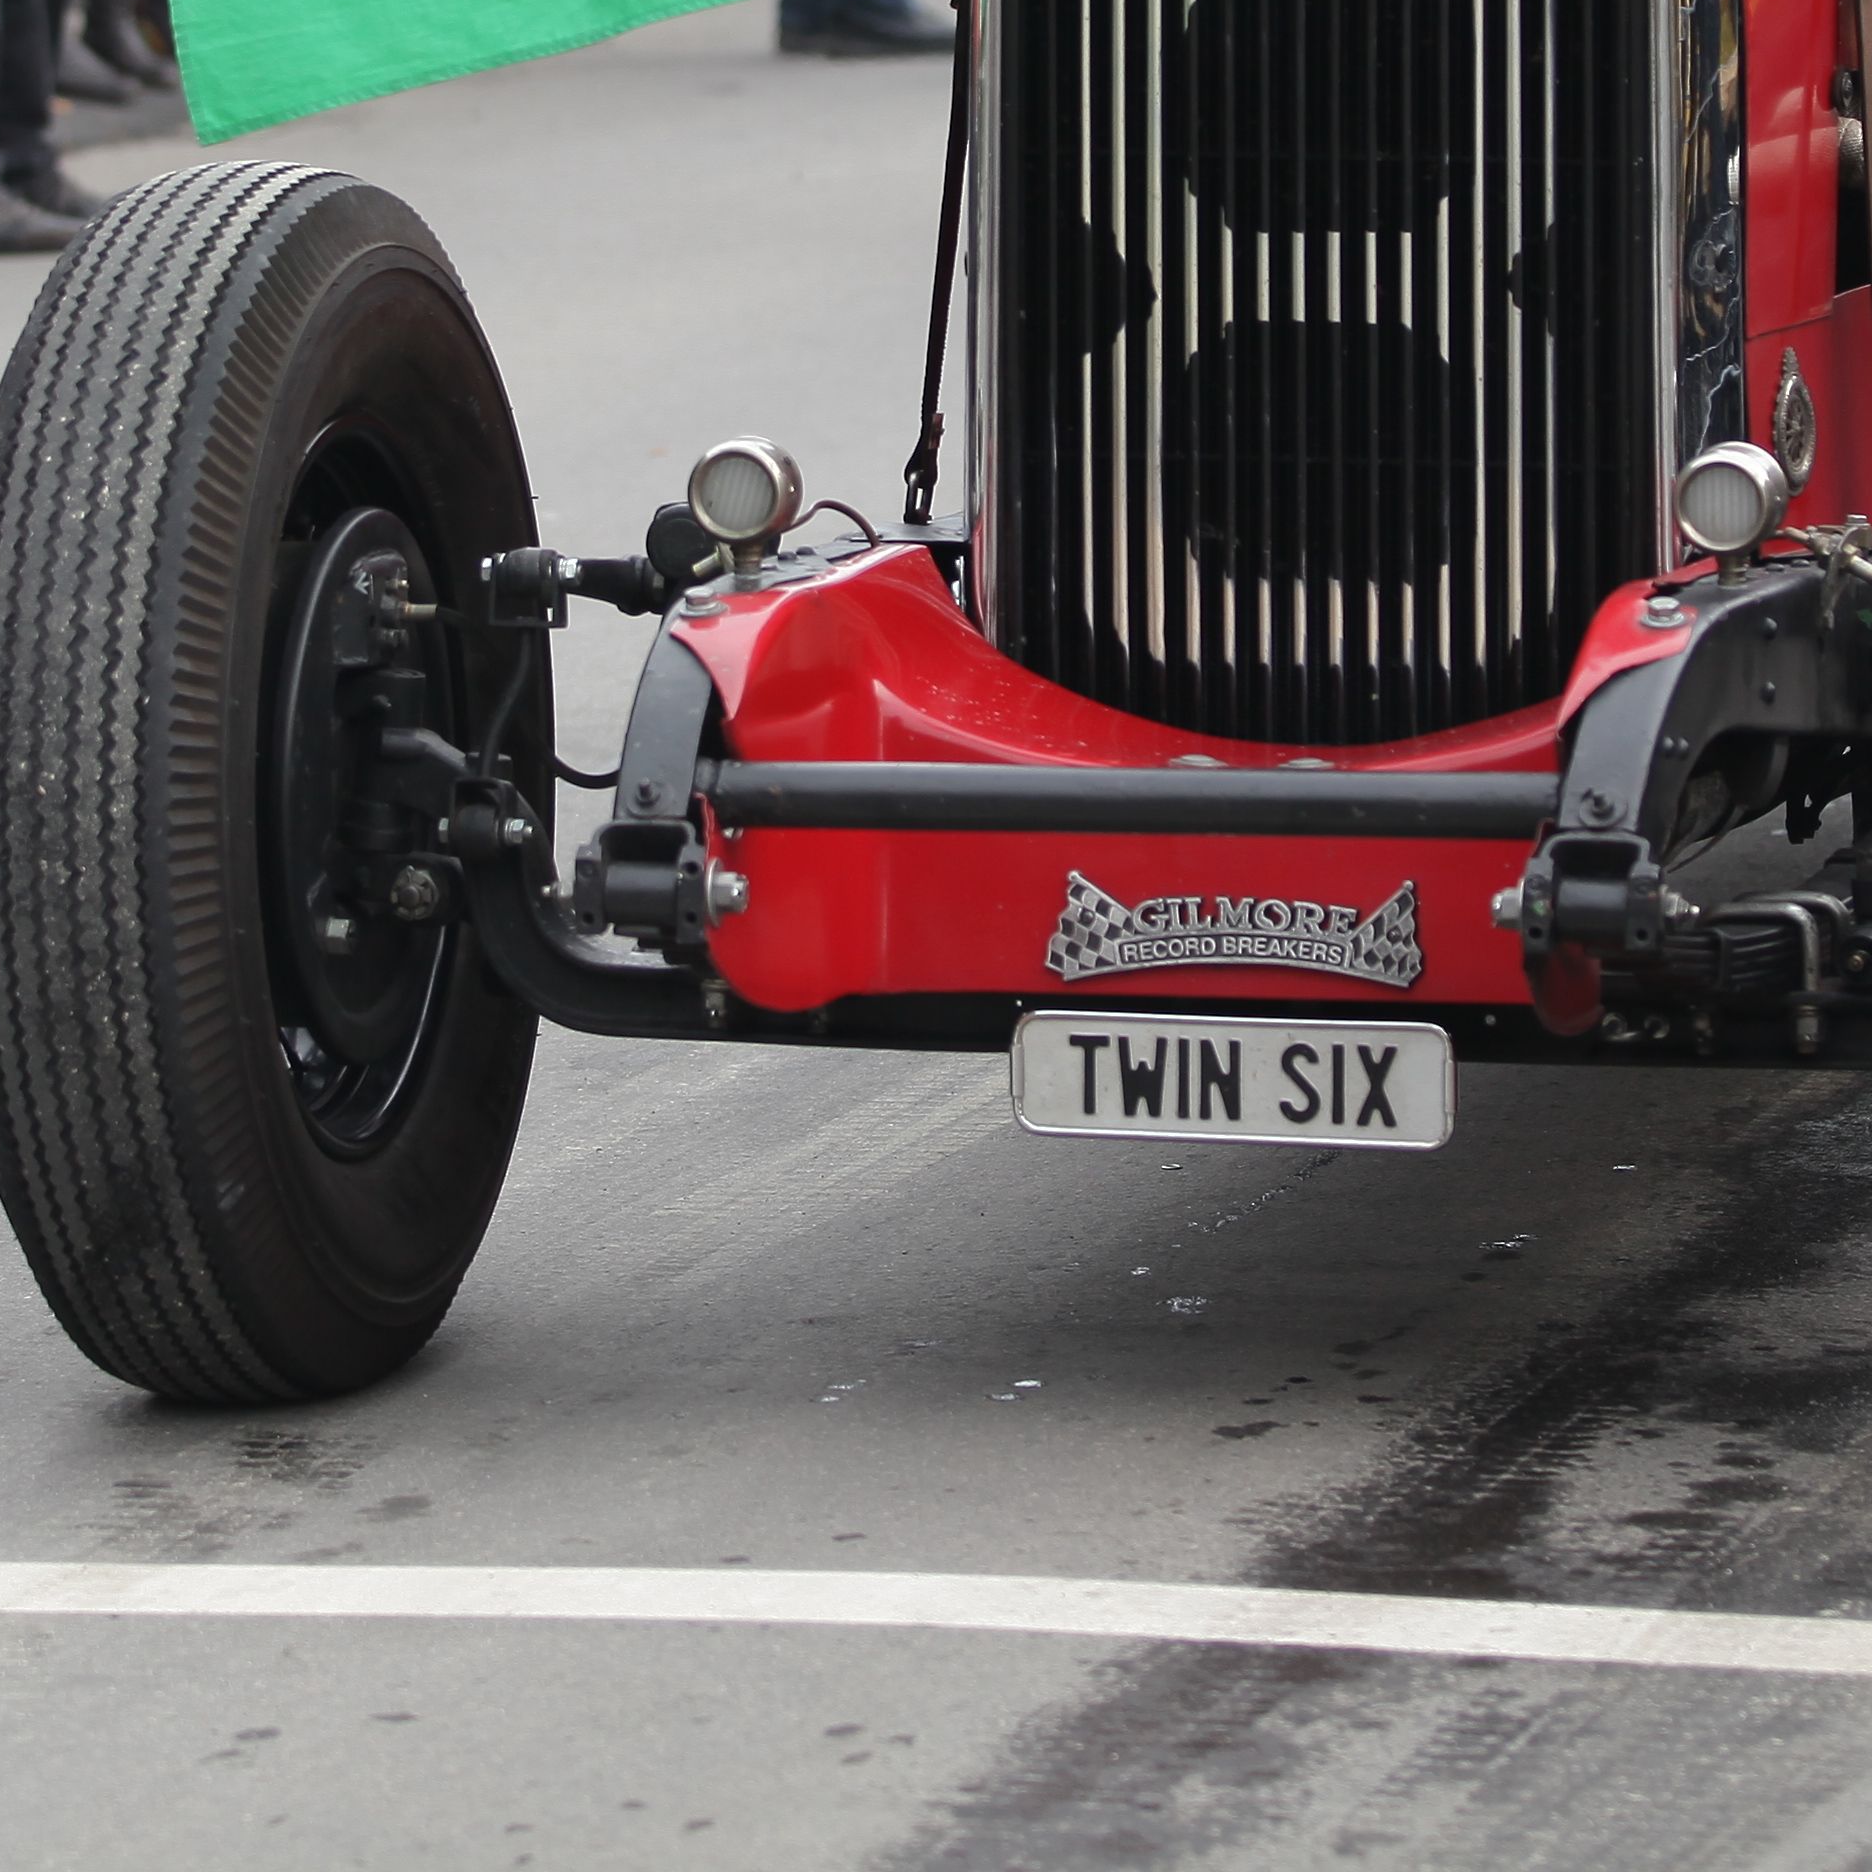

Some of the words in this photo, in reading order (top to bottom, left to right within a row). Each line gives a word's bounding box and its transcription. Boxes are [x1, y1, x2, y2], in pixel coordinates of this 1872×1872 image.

[1132, 896, 1358, 938] GILMORE
[1123, 936, 1217, 963] RECORD
[1222, 935, 1343, 965] BREAKERS
[1069, 1032, 1242, 1121] TWIN
[1279, 1040, 1399, 1128] SIX
